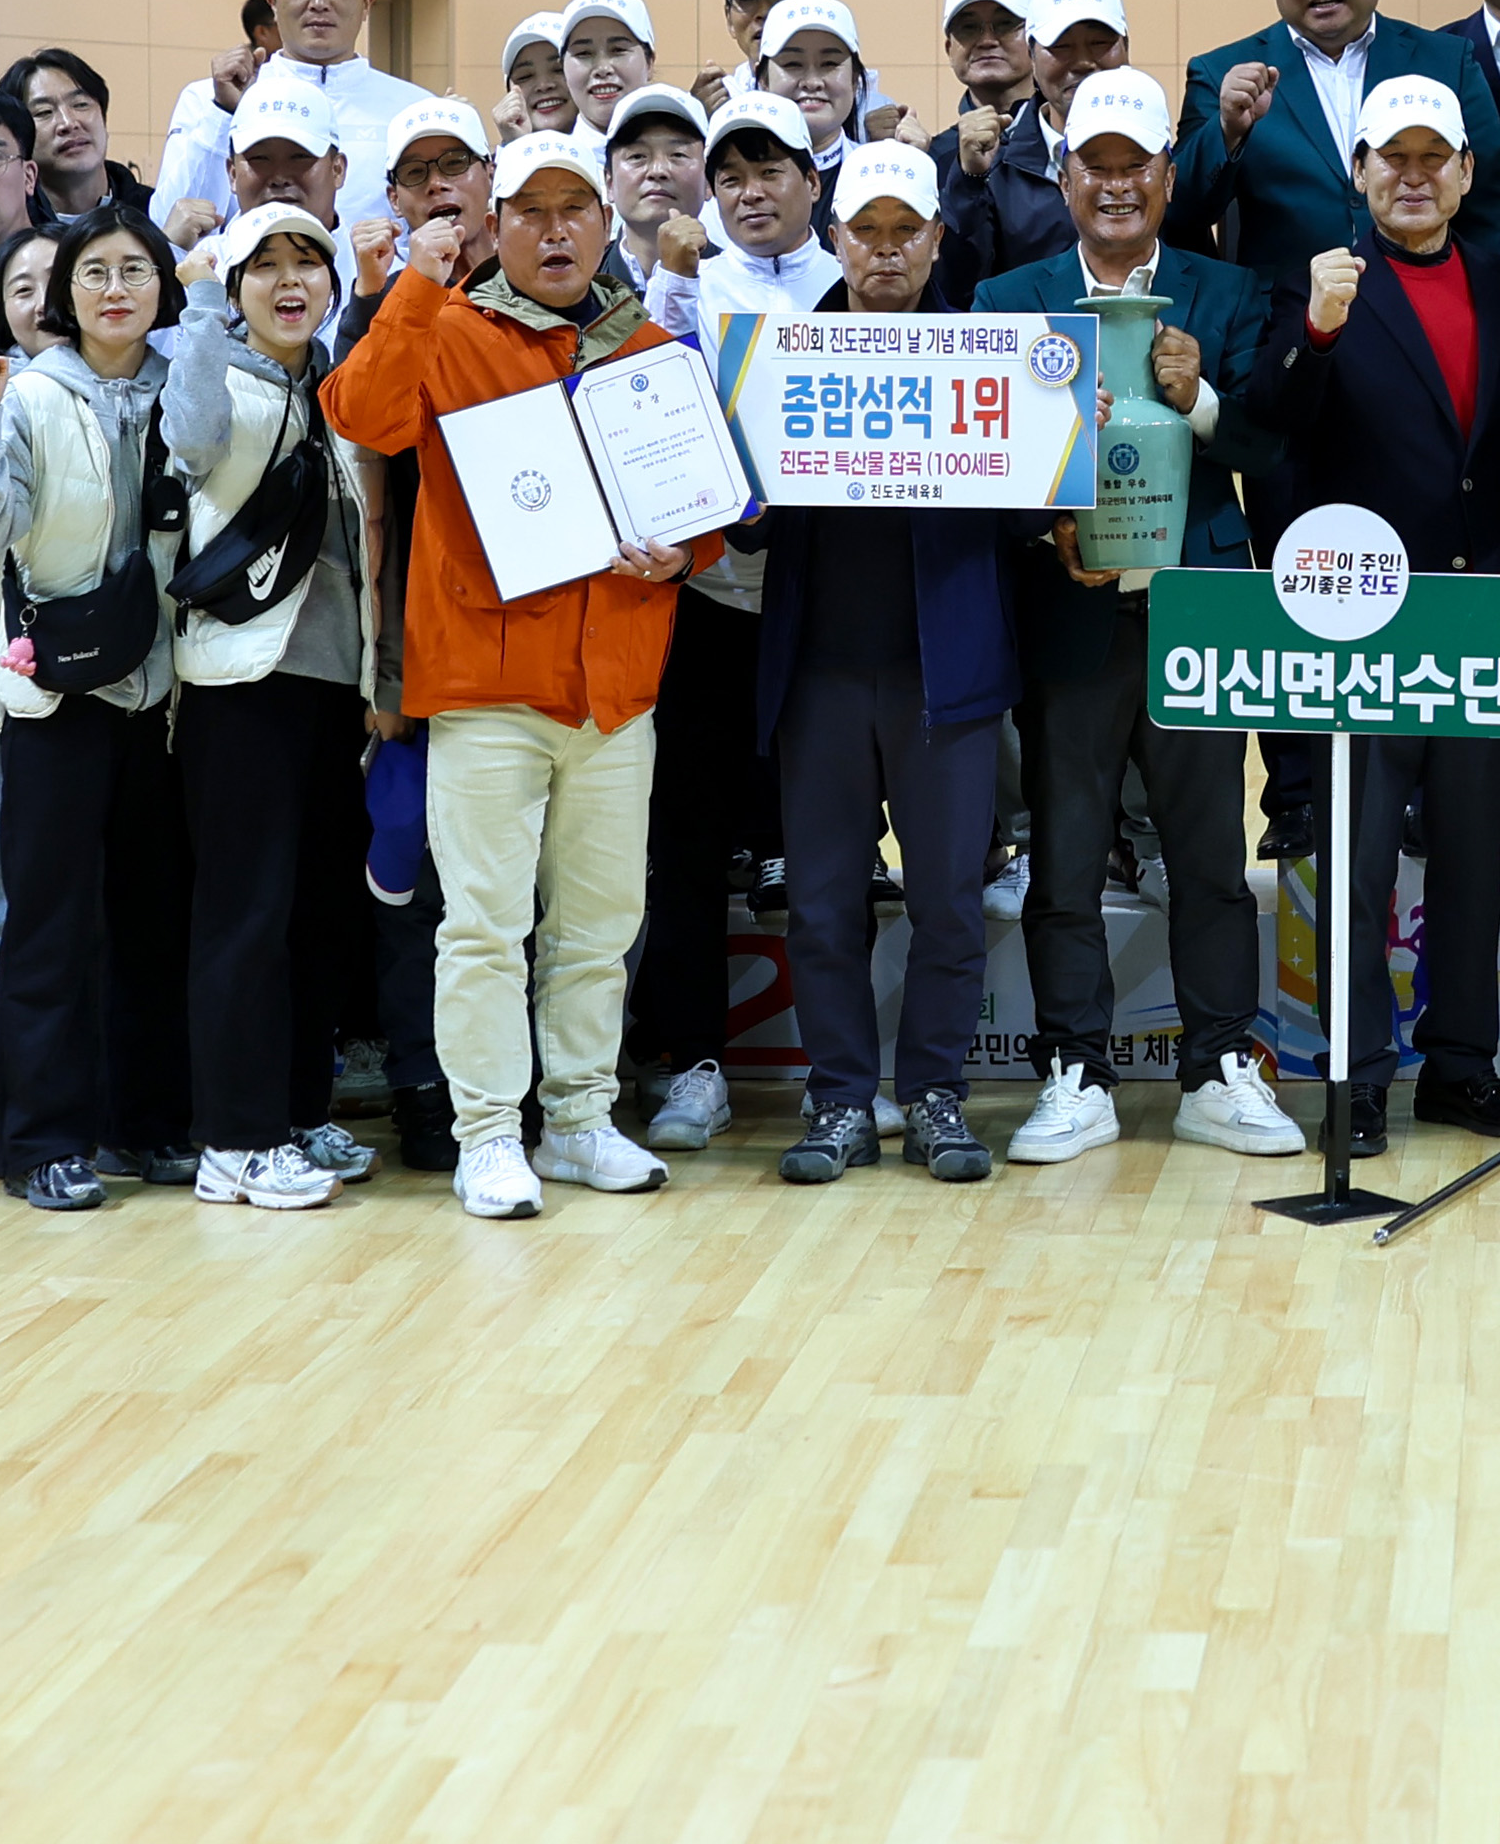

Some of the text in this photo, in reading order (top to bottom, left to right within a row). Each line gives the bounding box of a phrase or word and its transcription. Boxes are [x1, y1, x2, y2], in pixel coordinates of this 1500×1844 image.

[776, 323, 1018, 355] 제50회 진도군민의 날 기념 체육대회
[781, 372, 1009, 439] 종합성적 1위
[780, 451, 1010, 478] 진도군 특산물 잡곡 (100세트)
[870, 484, 943, 501] 진도군체육회
[246, 545, 278, 586] NIKE
[1295, 549, 1402, 572] 군민이 주인!
[1281, 574, 1399, 596] 살기좋은 진도
